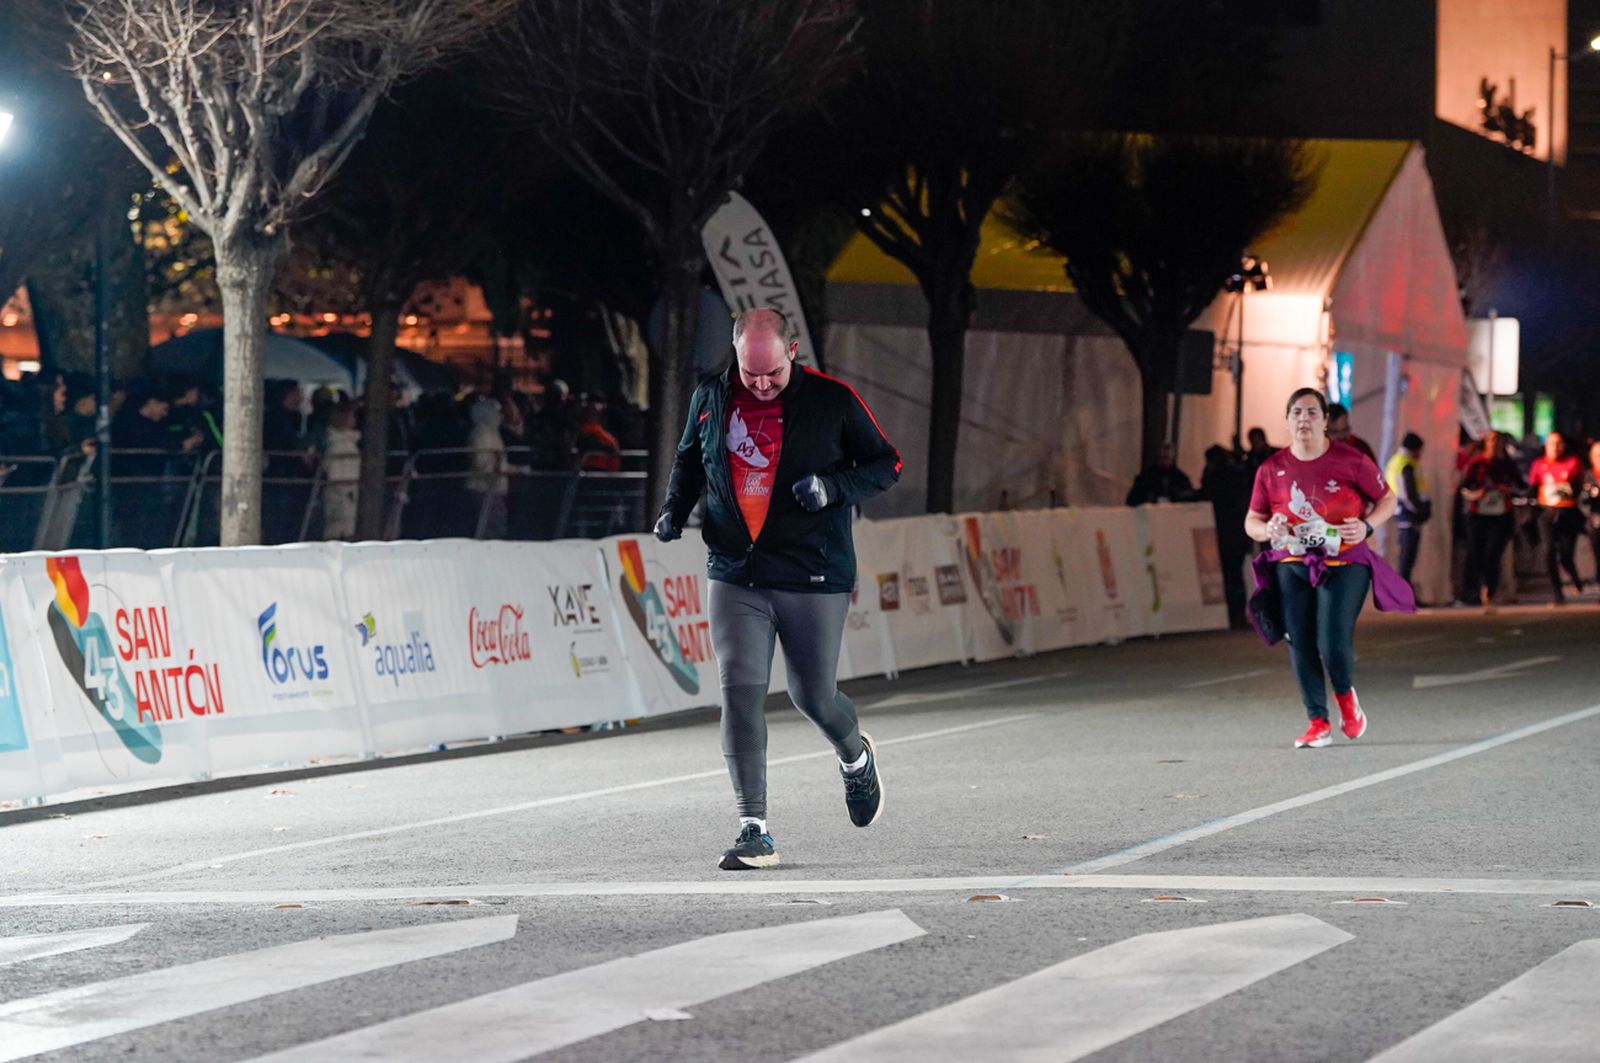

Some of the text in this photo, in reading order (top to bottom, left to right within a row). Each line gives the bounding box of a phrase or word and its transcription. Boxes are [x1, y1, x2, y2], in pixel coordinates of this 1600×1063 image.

[736, 442, 755, 457] 43
[663, 575, 702, 619] SAN
[115, 605, 171, 661] SAN
[374, 630, 437, 688] aqualia
[645, 598, 675, 664] 43
[677, 621, 713, 665] ANT
[84, 636, 125, 721] 43
[135, 648, 224, 724] ANTÓN
